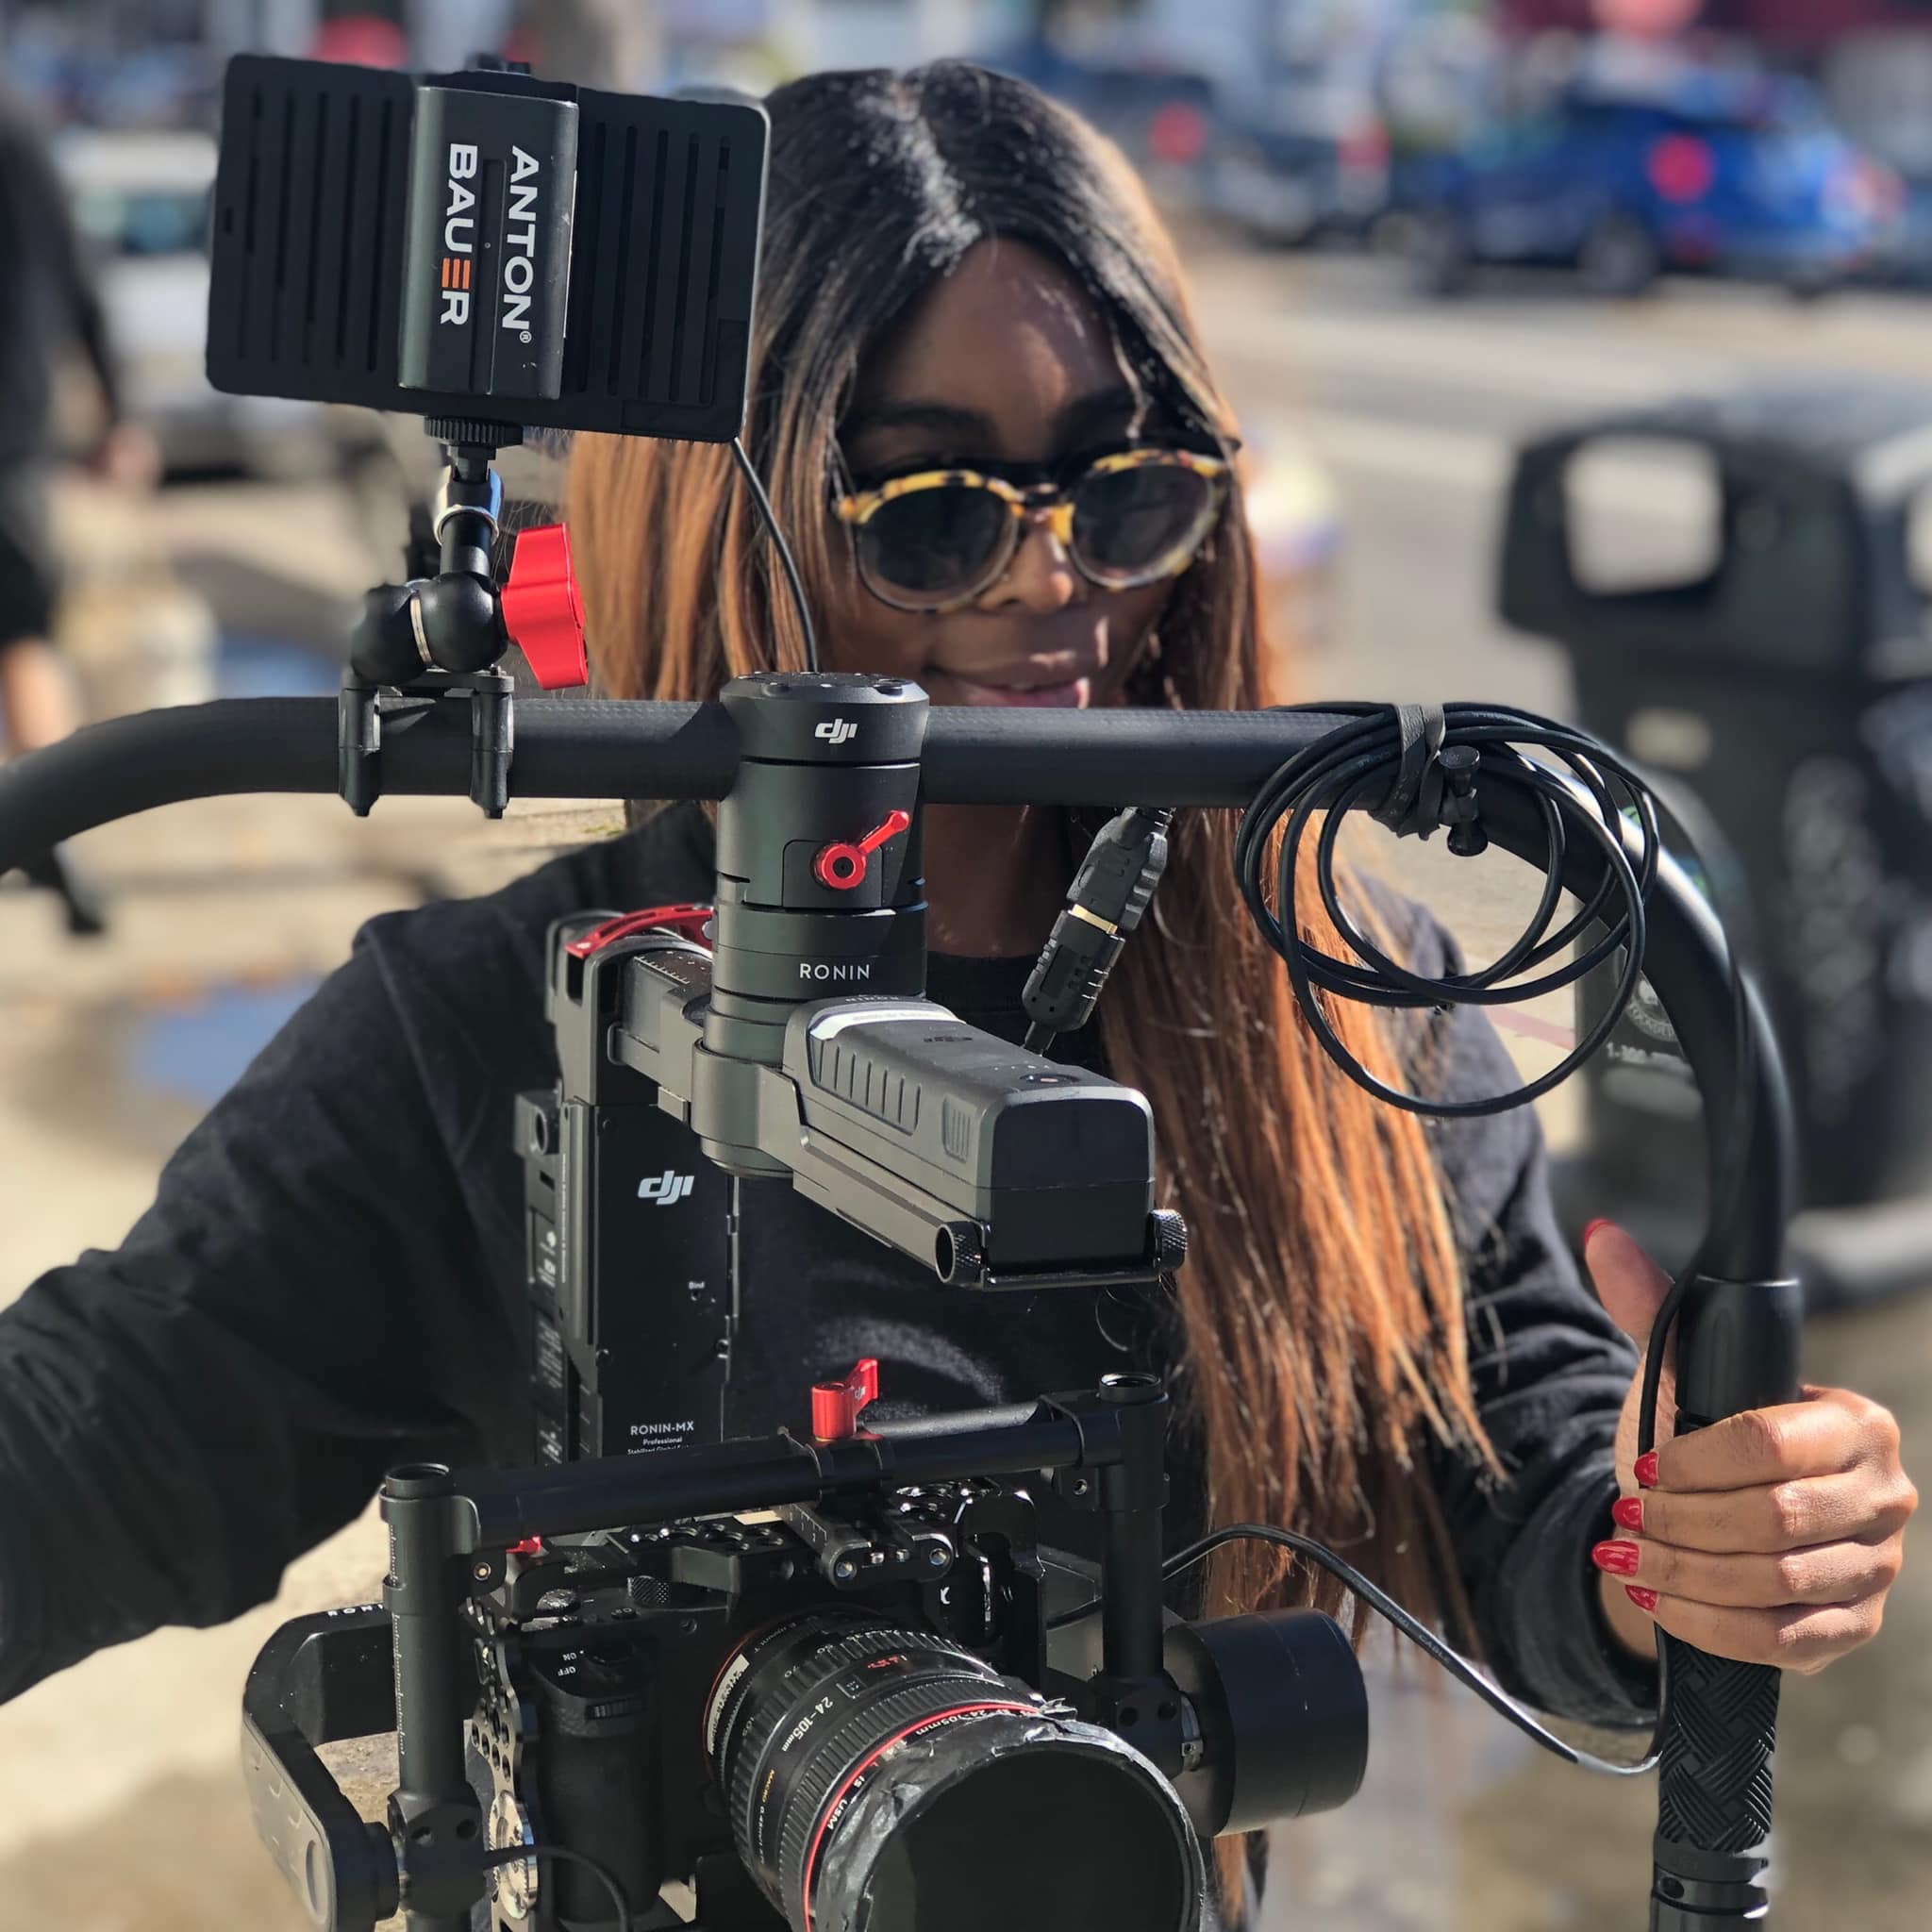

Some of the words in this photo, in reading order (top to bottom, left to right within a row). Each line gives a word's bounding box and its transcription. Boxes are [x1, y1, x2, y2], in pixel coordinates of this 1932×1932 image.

[440, 142, 478, 325] BAUER
[799, 963, 871, 980] RONIN
[630, 1421, 694, 1436] RONIN-MX
[827, 1798, 847, 1830] USM
